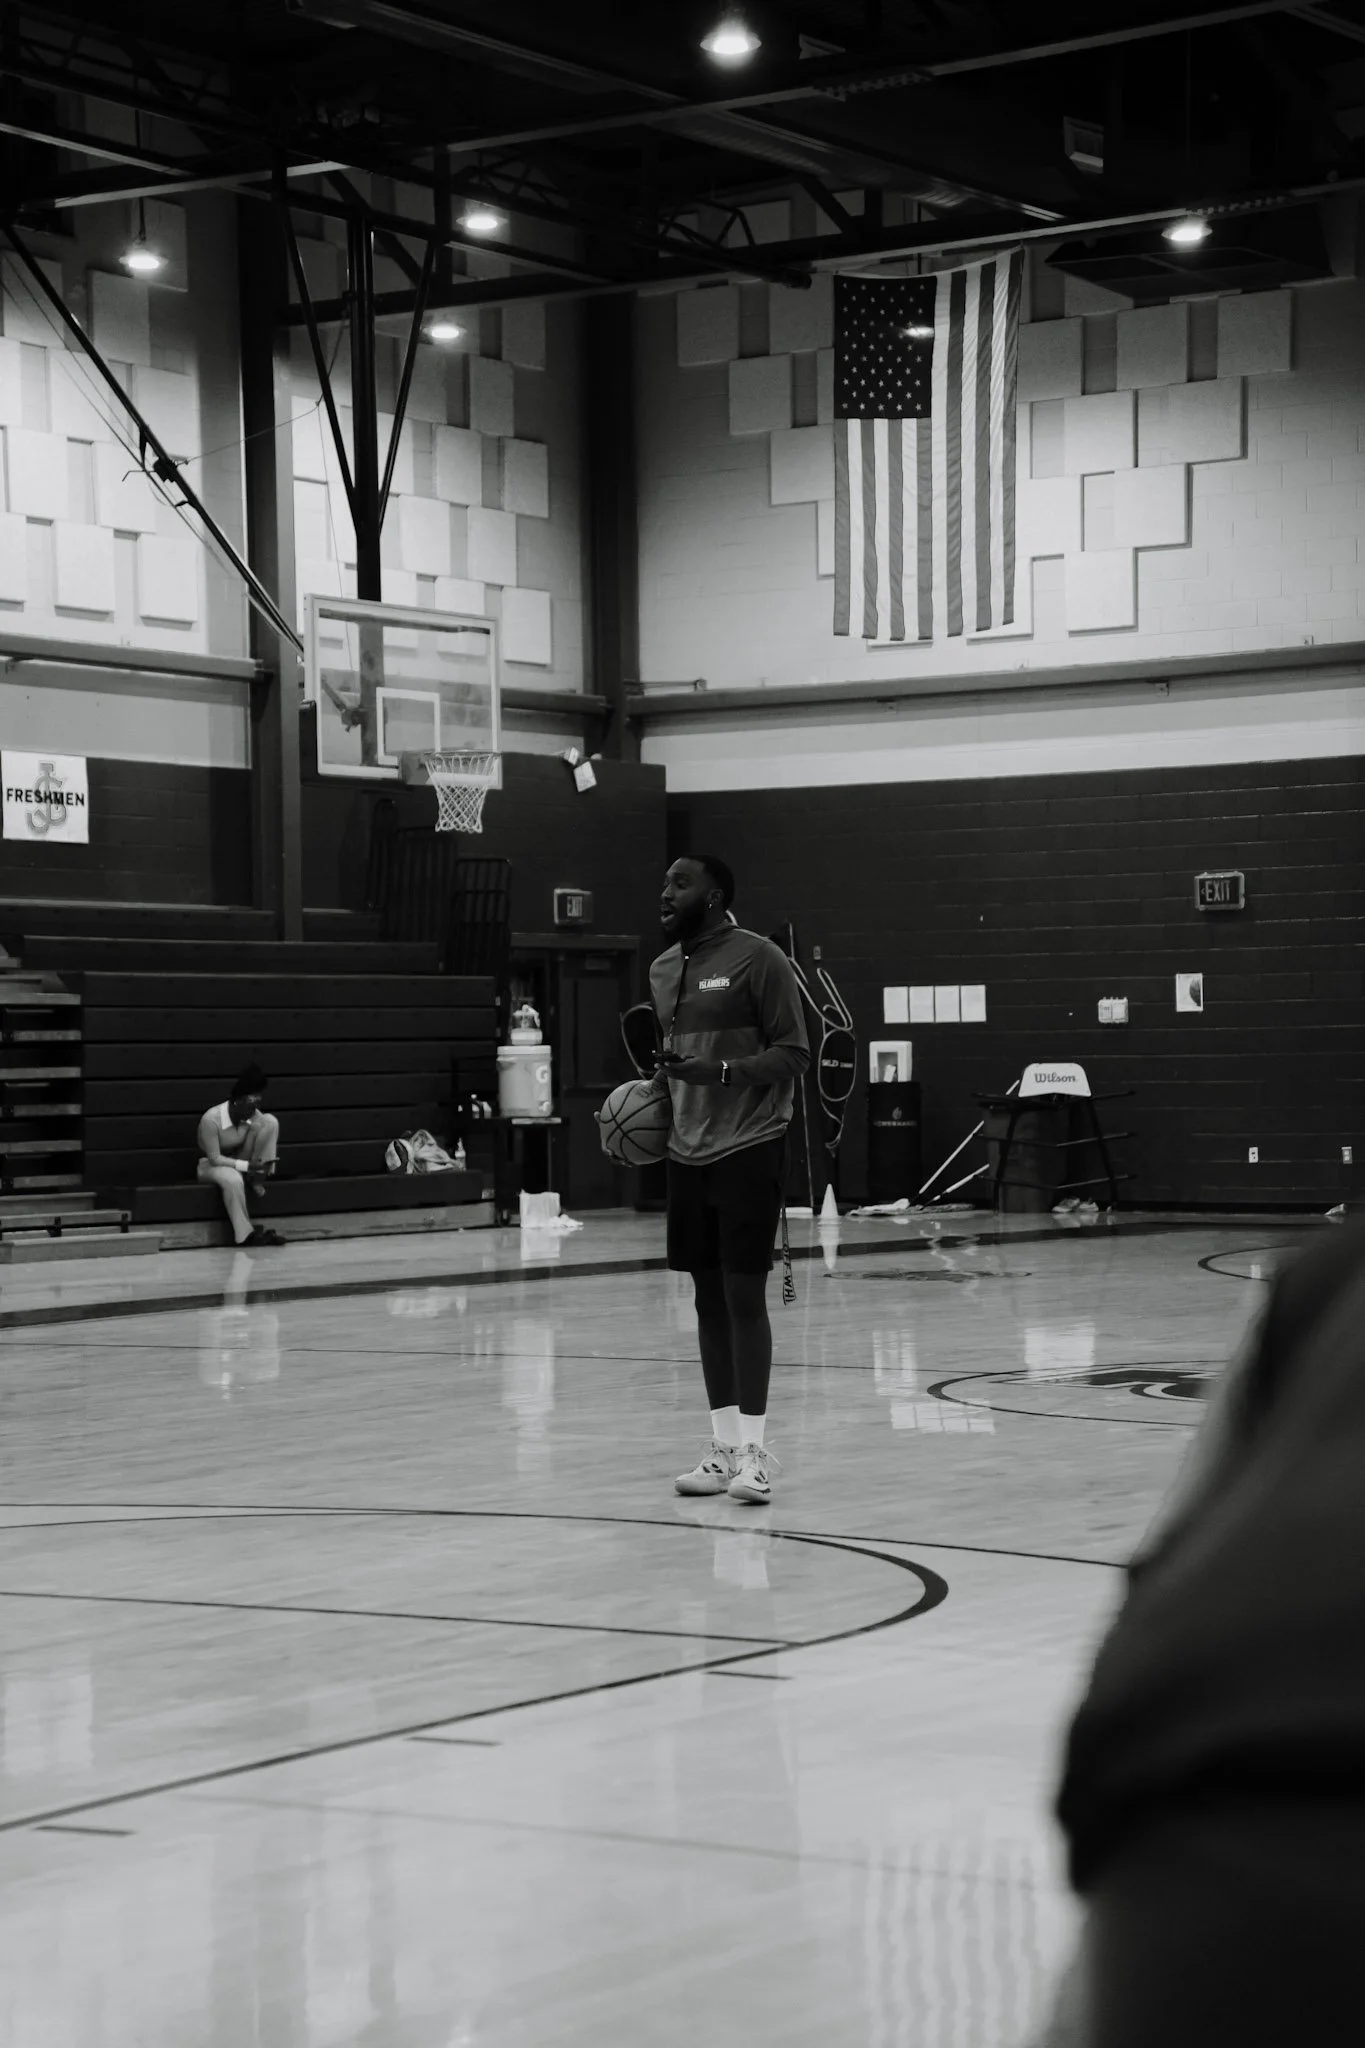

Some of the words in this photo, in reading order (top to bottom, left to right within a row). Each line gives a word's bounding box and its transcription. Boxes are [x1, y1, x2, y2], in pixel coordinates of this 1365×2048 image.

[6, 788, 85, 807] FRESHMEN
[1205, 880, 1230, 902] EXIT
[699, 978, 730, 989] ISLANDERS
[1034, 1071, 1076, 1083] Wilson
